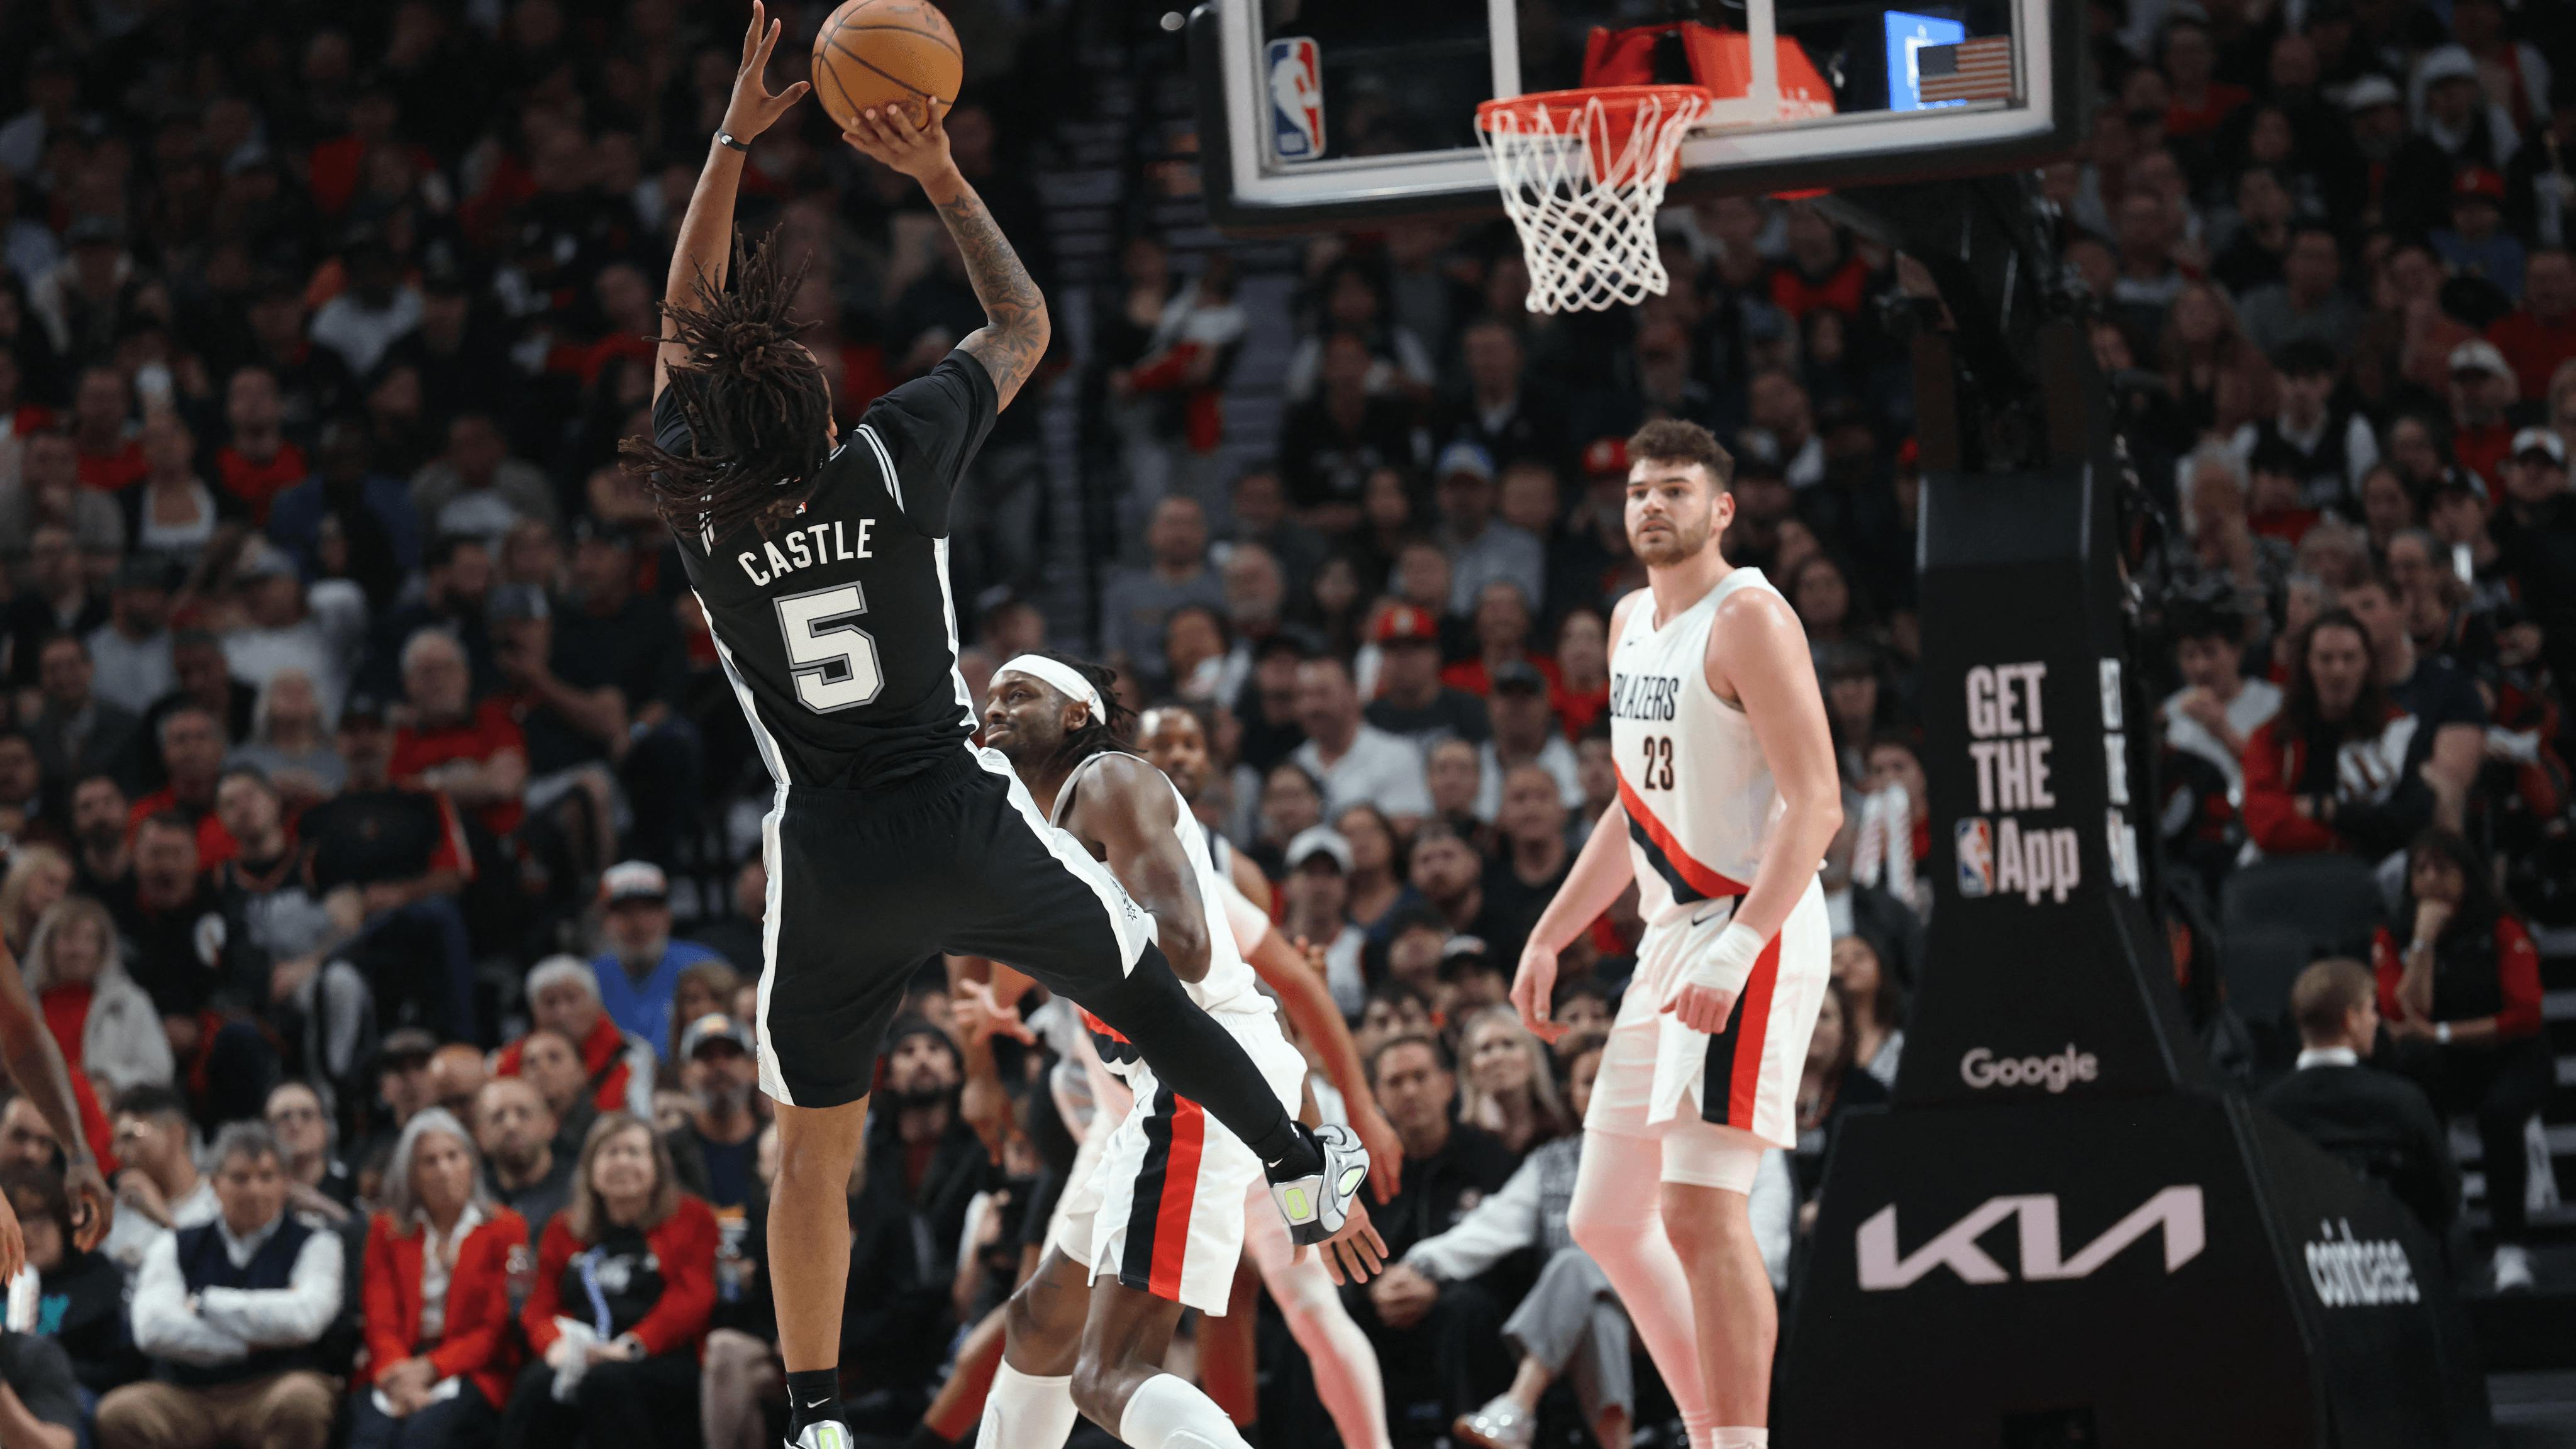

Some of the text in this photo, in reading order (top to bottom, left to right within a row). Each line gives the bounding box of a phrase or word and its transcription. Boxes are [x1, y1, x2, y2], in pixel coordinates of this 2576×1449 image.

[738, 519, 875, 586] CASTLE
[772, 580, 885, 714] 5
[1966, 661, 2047, 738] GET
[1644, 736, 1674, 791] 23
[1969, 736, 2056, 812] THE
[1997, 817, 2081, 904] App
[1960, 1042, 2099, 1093] Google
[1856, 1184, 2206, 1291] KIA
[2305, 1217, 2420, 1307] coinbase
